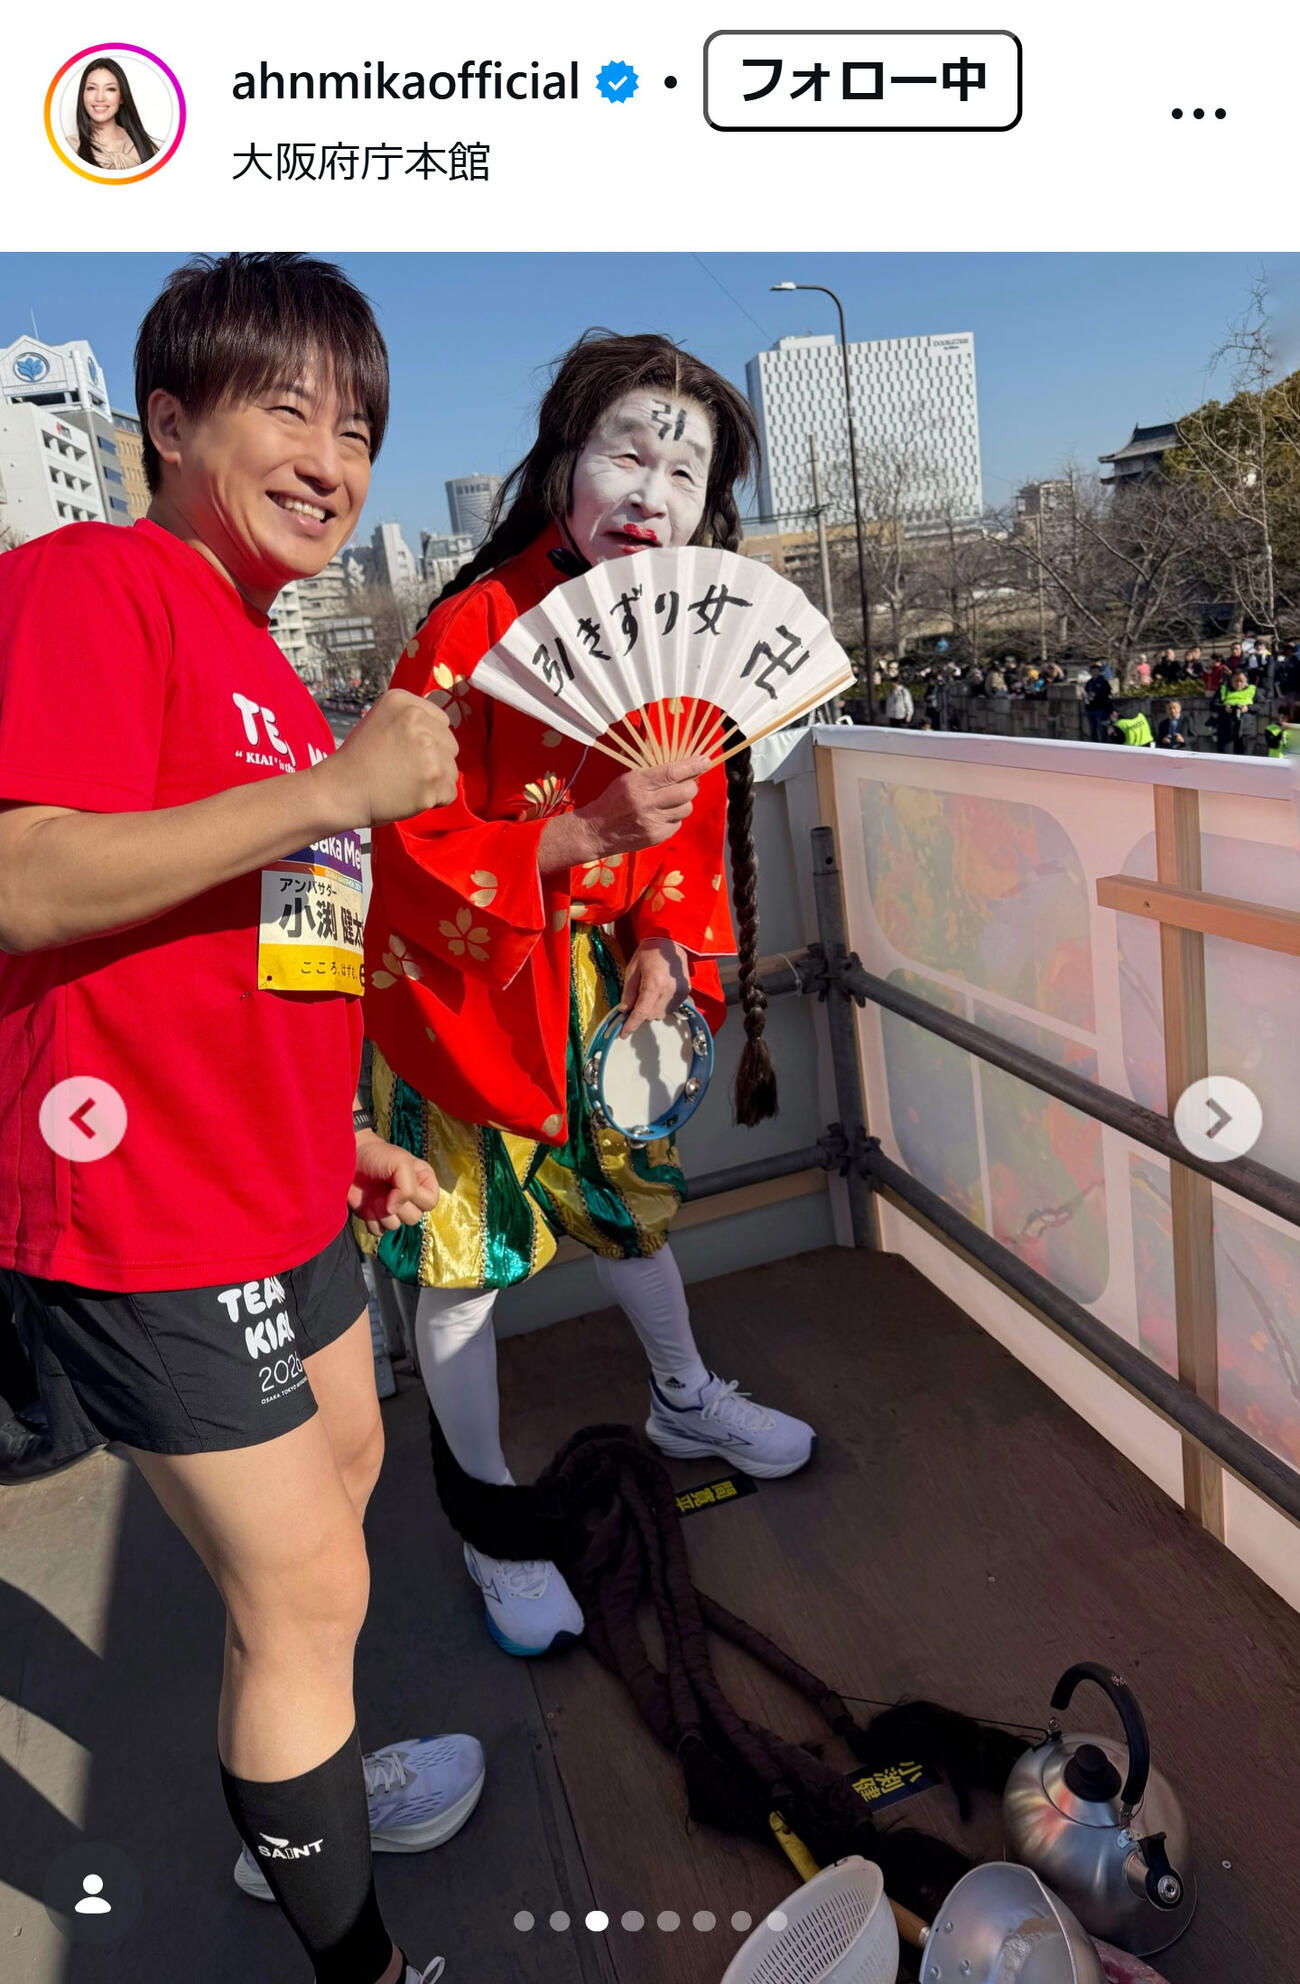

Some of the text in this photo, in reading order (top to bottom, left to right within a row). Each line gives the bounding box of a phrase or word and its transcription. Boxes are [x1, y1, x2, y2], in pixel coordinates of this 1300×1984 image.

[651, 399, 686, 441] 引
[532, 583, 753, 697] 引きずり女
[258, 1351, 303, 1392] 2026
[261, 1393, 280, 1405] OSAKA
[258, 1838, 324, 1860] SAINT
